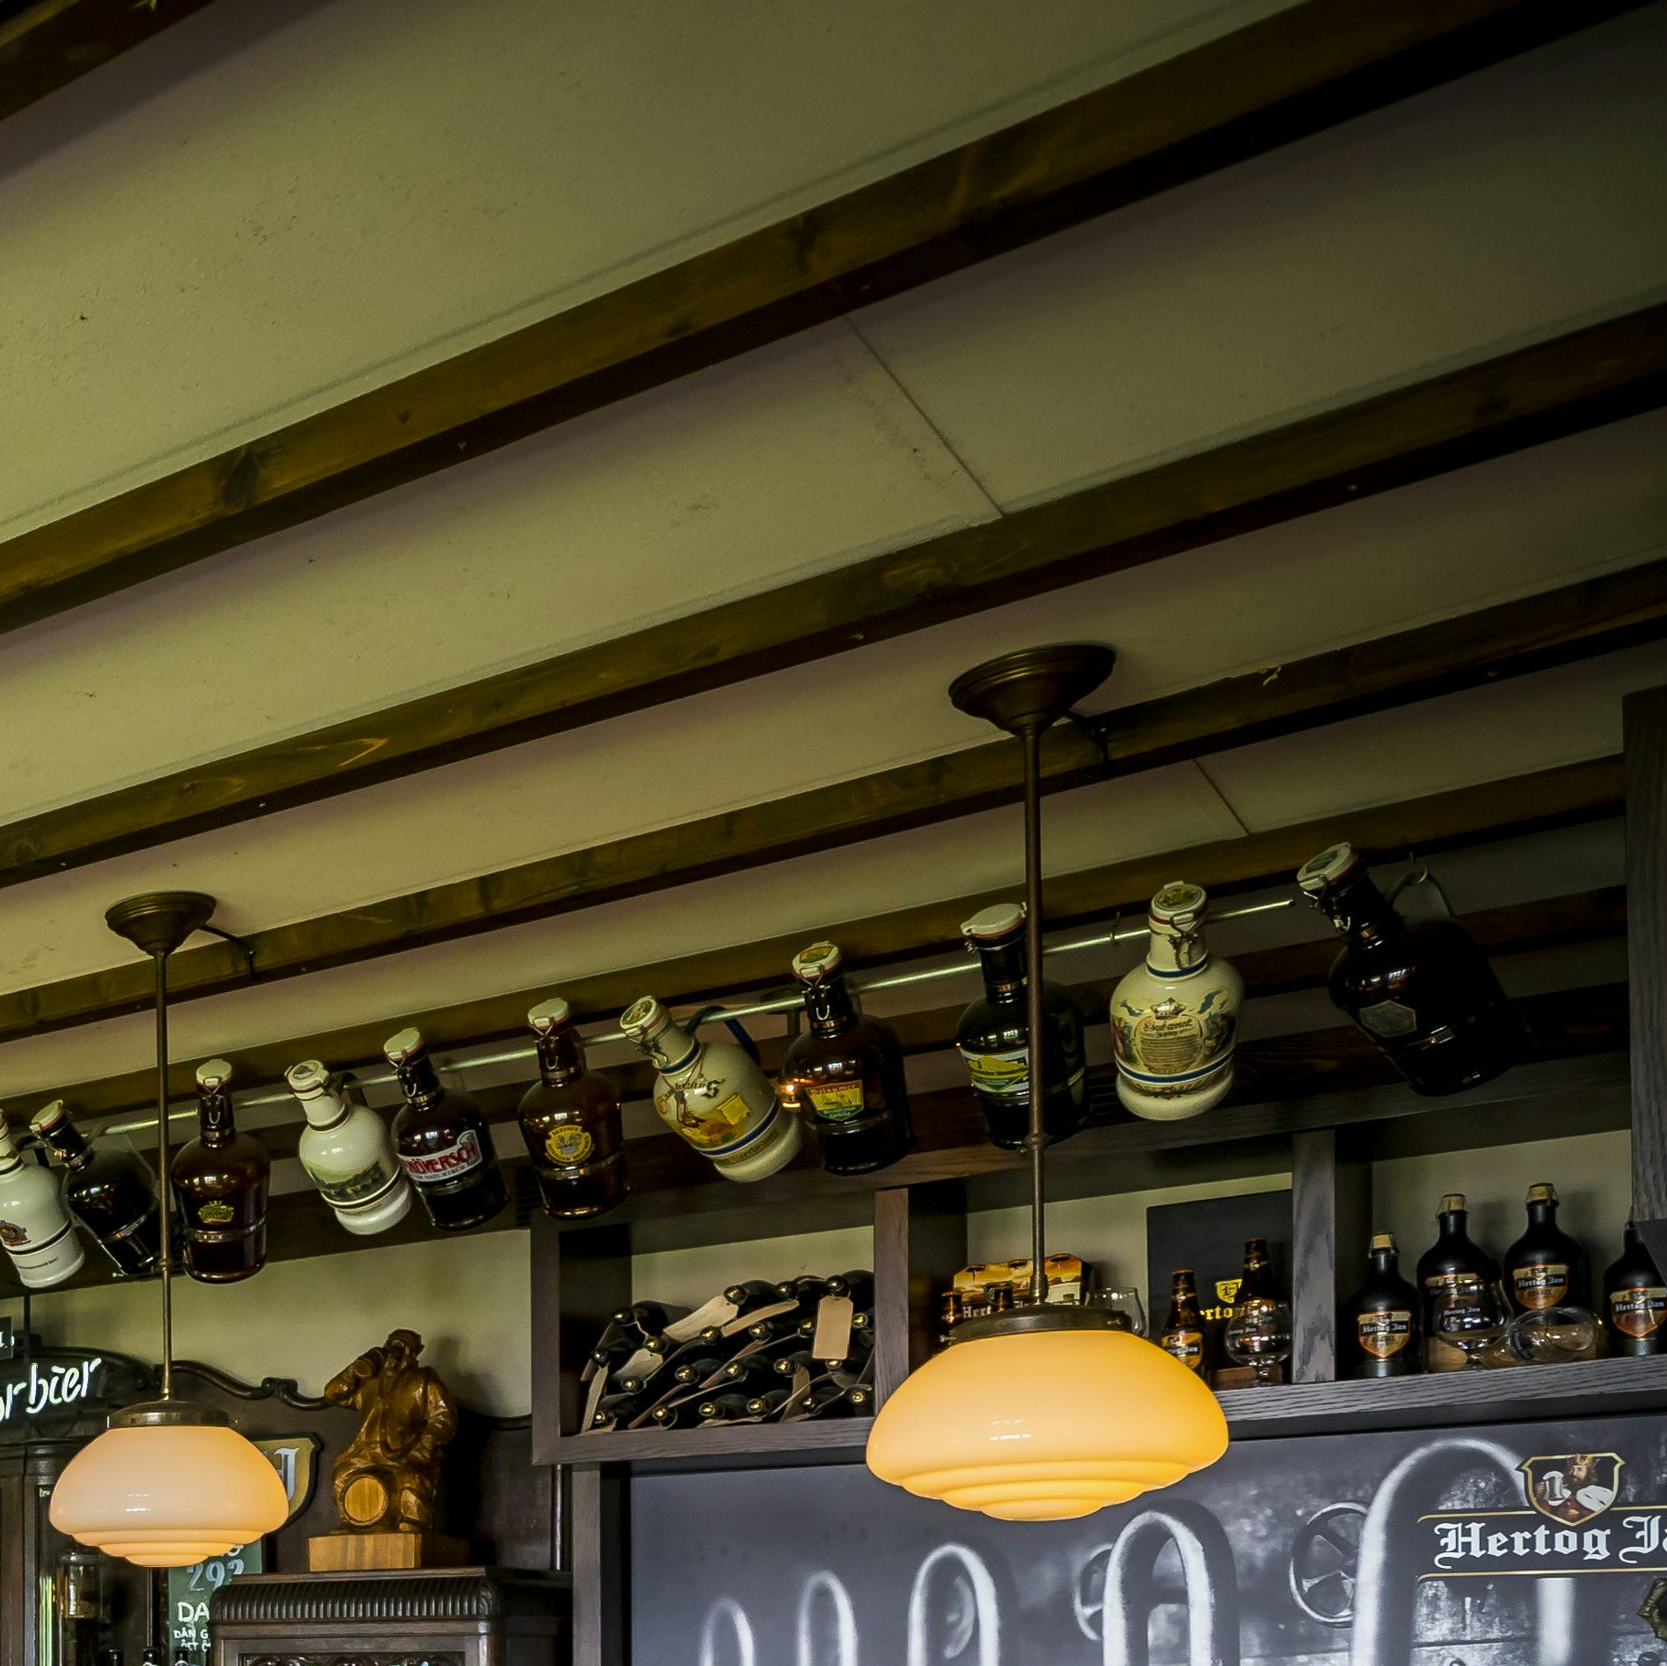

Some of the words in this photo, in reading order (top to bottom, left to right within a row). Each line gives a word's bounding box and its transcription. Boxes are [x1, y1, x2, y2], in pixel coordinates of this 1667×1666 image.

[1201, 1308, 1234, 1320] erto
[26, 1358, 102, 1414] bier
[1433, 1521, 1611, 1569] Hertog
